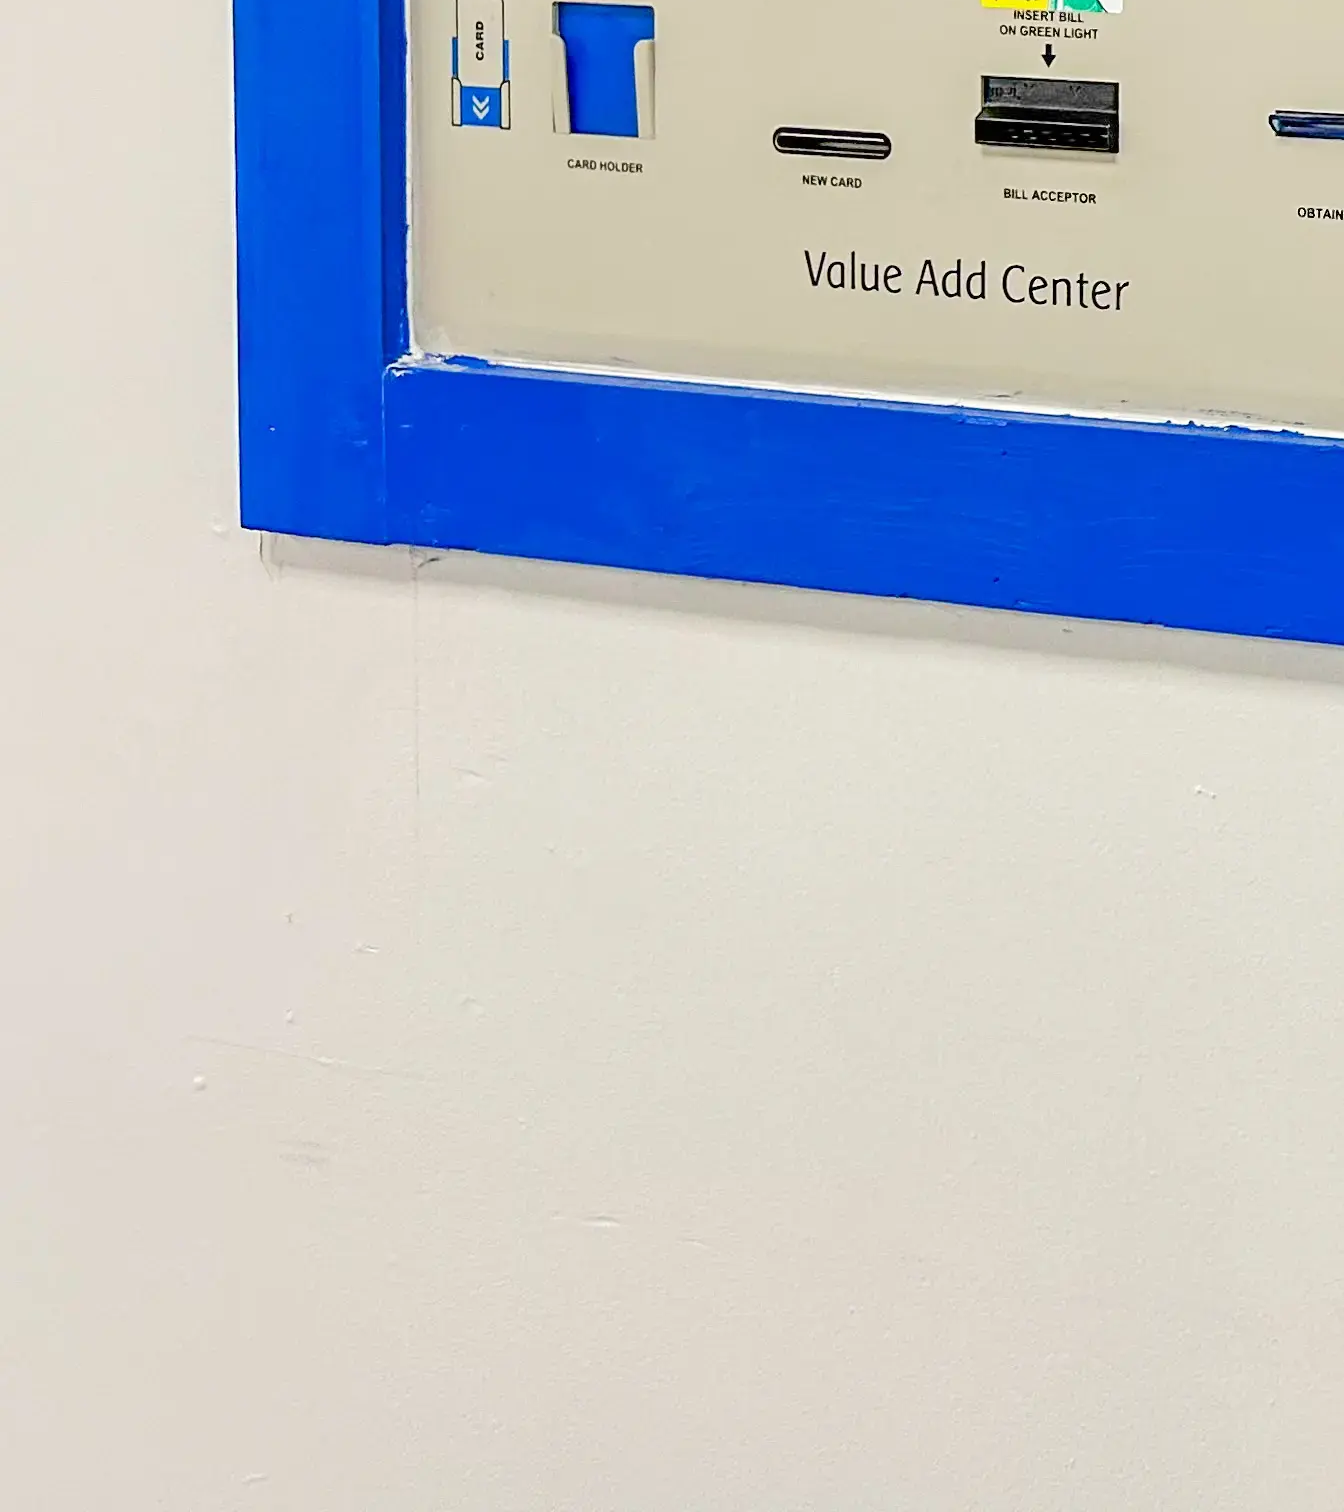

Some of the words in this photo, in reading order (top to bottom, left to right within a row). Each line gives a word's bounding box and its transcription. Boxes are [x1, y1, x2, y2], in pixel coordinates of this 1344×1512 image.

[1014, 10, 1055, 22] INSERT
[1059, 12, 1084, 23] BILL
[1000, 25, 1016, 35] ON
[1020, 26, 1060, 37] GREEN
[1064, 28, 1098, 39] LIGHT
[475, 20, 485, 61] CARD
[567, 159, 597, 173] CARD
[599, 160, 643, 174] HOLDER
[802, 175, 829, 187] NEW
[831, 176, 862, 189] CARD
[1004, 188, 1028, 200] BILL
[1032, 190, 1096, 204] ACCEPTOR
[1297, 207, 1343, 220] OBTAIN
[804, 249, 903, 294] Value
[916, 259, 987, 299] Add
[1002, 266, 1130, 311] Center
